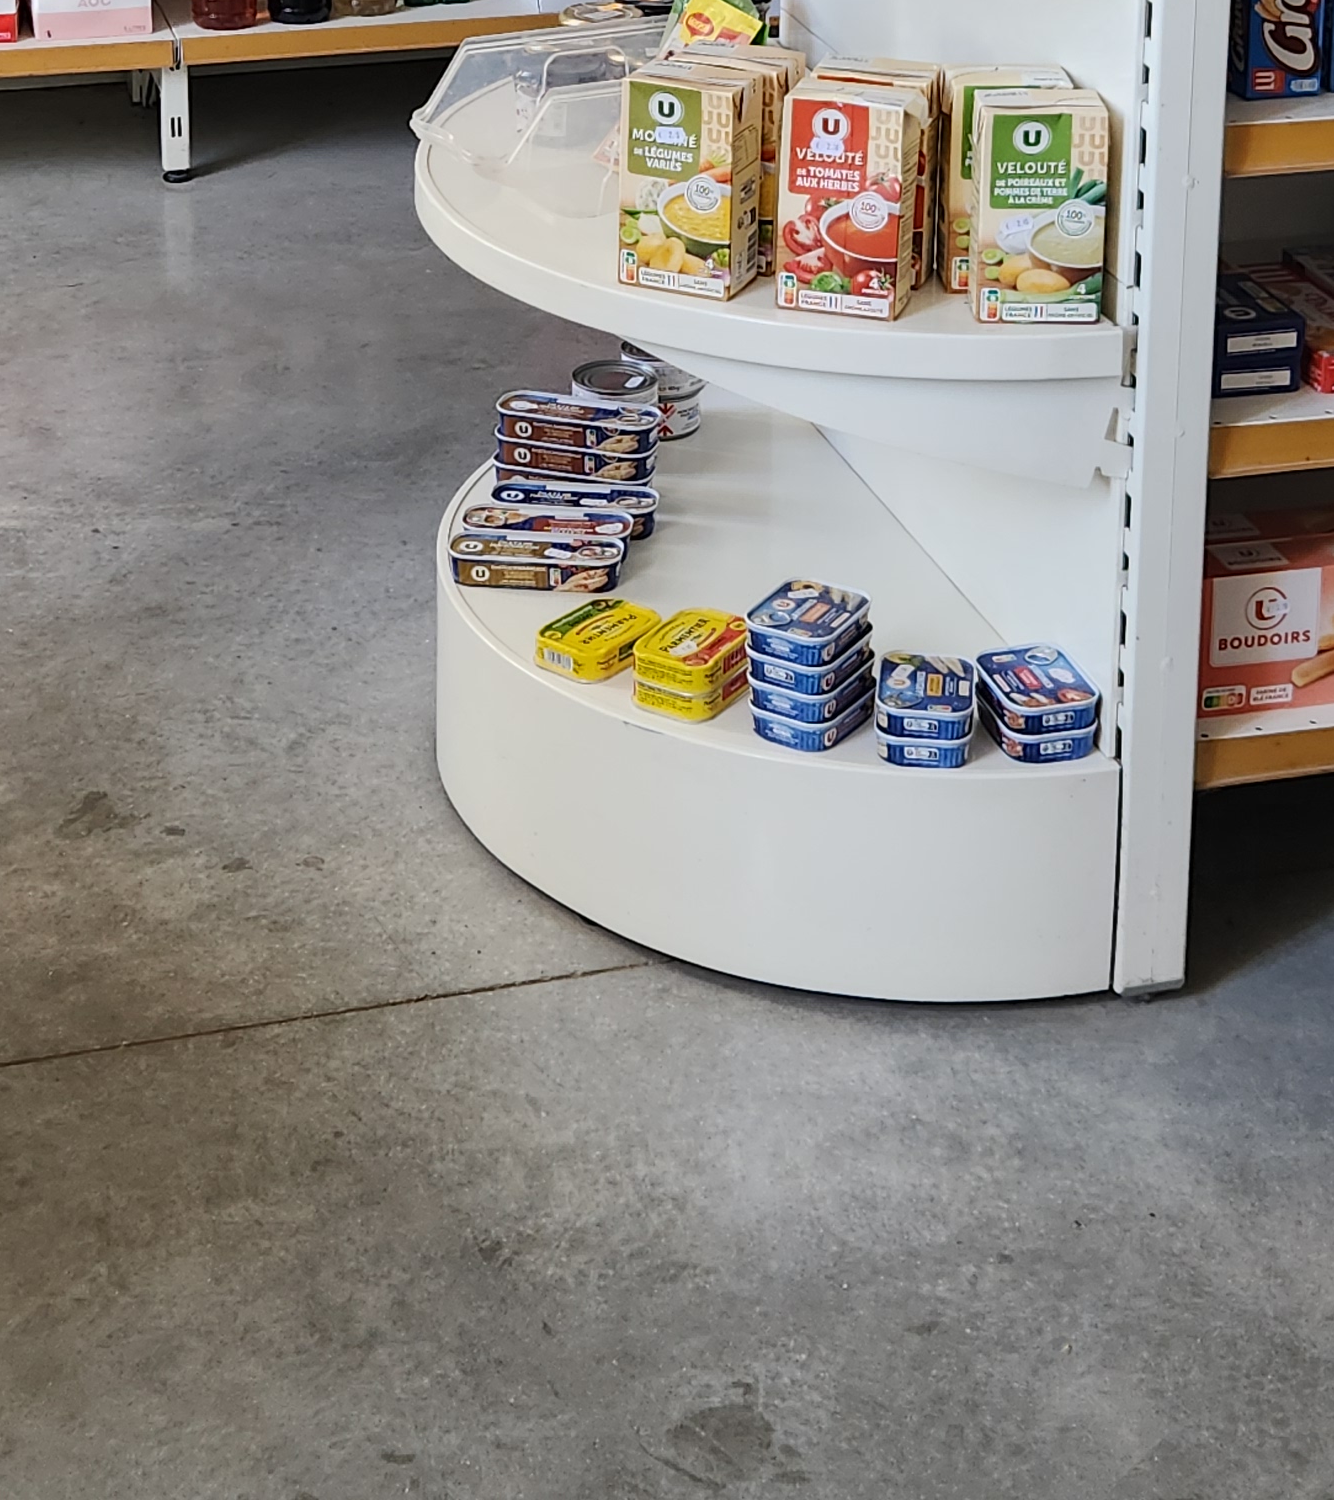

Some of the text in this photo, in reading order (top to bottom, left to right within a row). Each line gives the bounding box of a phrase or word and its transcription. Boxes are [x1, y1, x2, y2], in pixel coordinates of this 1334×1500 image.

[1254, 71, 1276, 92] LU
[644, 145, 694, 163] LÉGUMES
[796, 147, 864, 167] VELOUTÉ
[645, 157, 683, 172] VARIÉS
[997, 160, 1067, 174] VELOUTÉ
[808, 166, 860, 181] TOMATES
[796, 176, 860, 191] AUX HERBES
[1007, 178, 1066, 187] POIREAUX ET
[1041, 187, 1067, 196] TERRE
[1025, 195, 1053, 204] CRÈME
[705, 258, 715, 270] 4
[869, 276, 880, 288] 4
[1076, 283, 1086, 295] 4
[1218, 629, 1312, 651] BOUDOIRS
